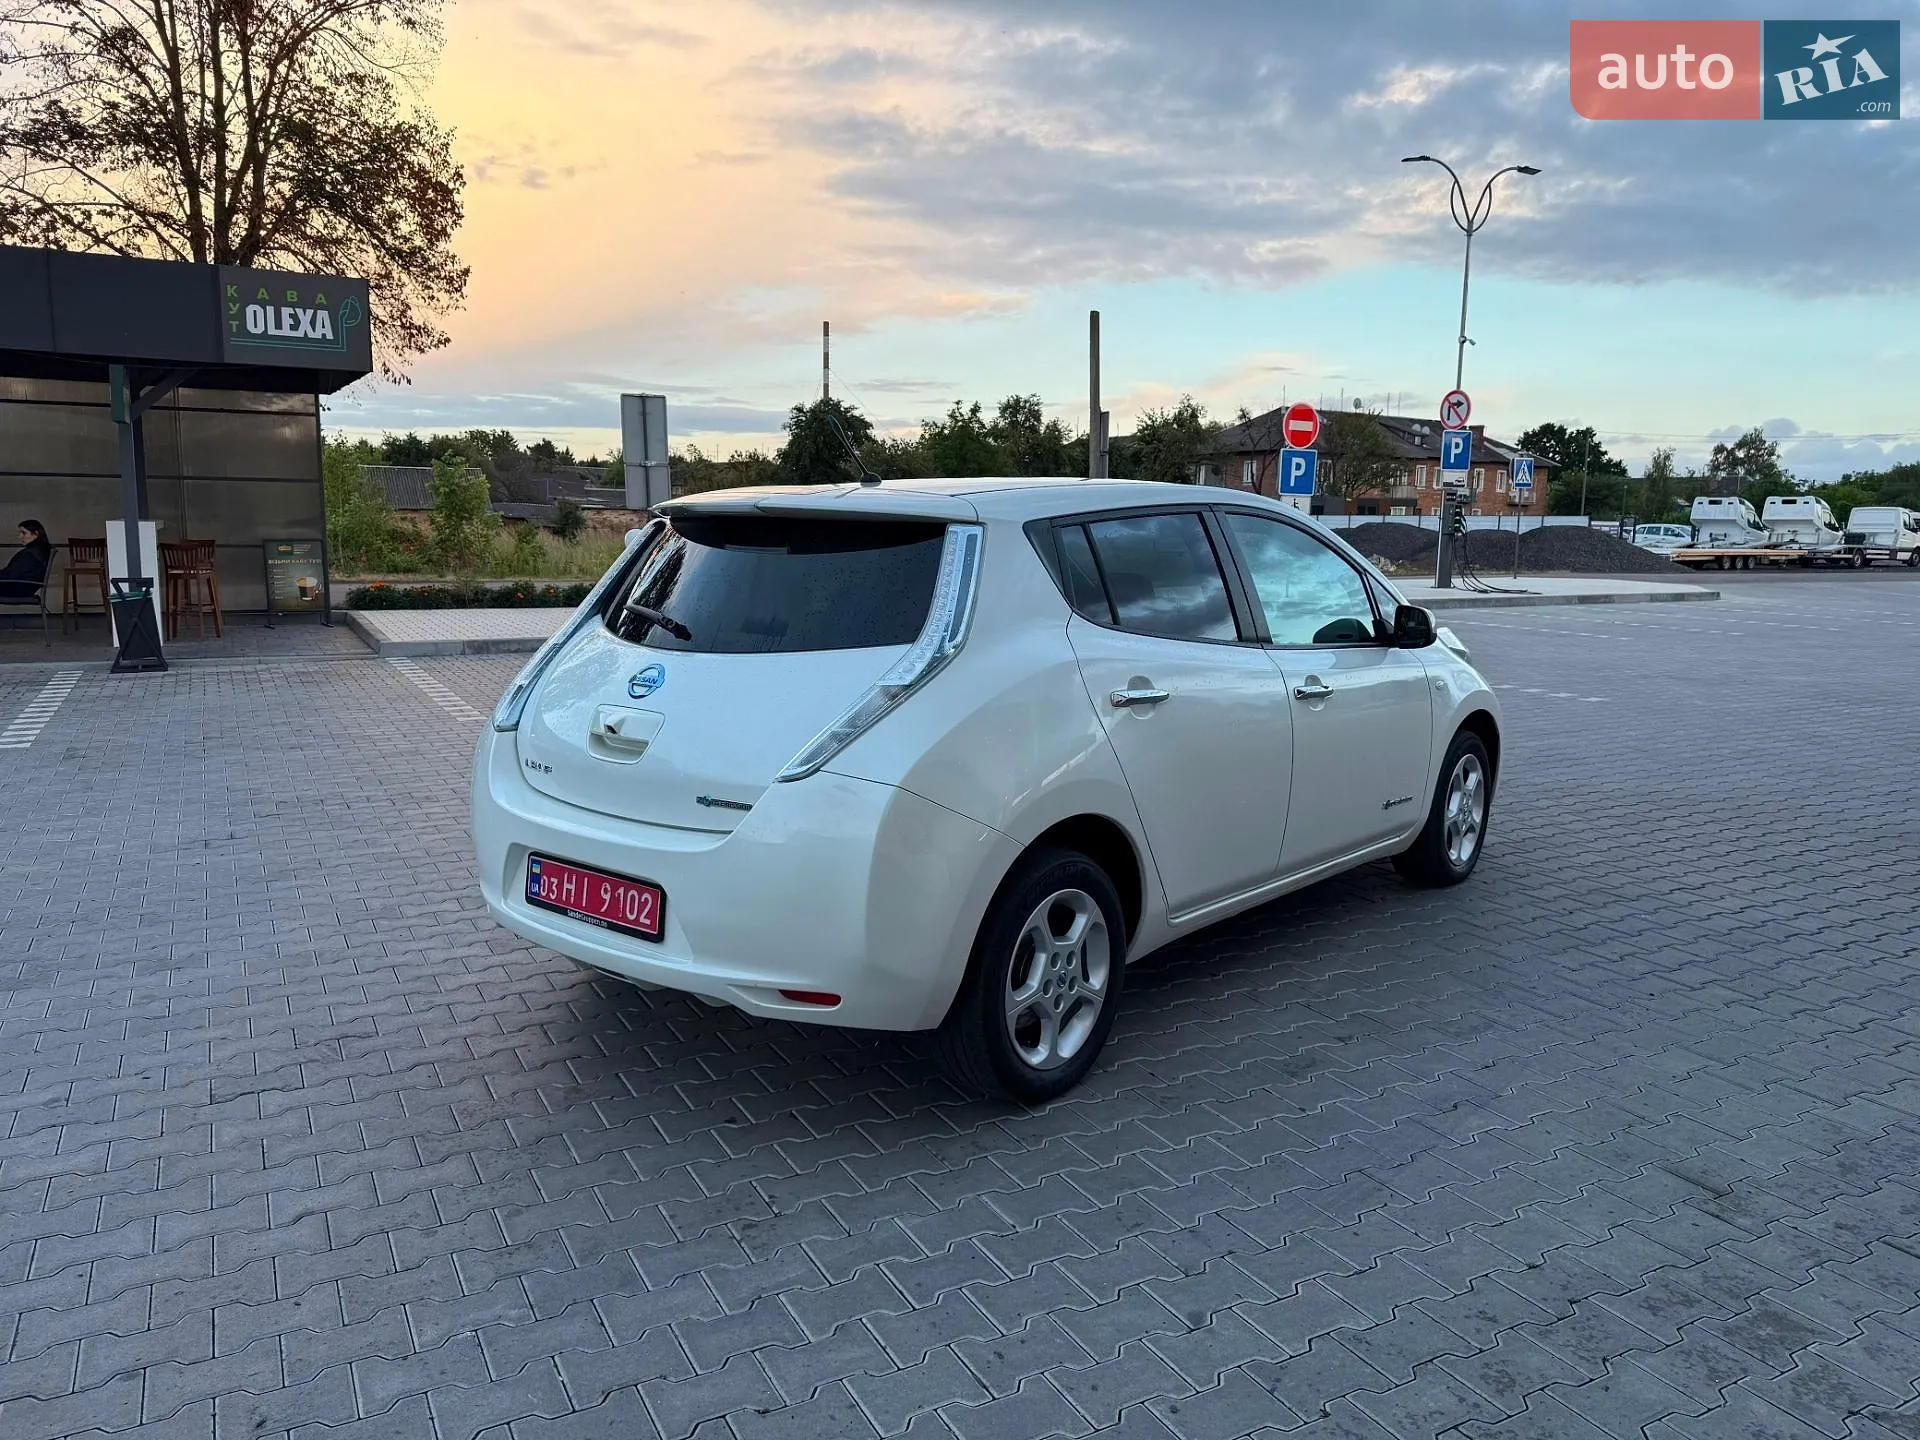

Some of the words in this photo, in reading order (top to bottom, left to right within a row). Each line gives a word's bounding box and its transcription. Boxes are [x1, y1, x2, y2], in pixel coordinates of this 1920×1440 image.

[245, 304, 334, 340] OLEXA
[1450, 437, 1464, 464] P
[1290, 457, 1306, 487] P
[531, 882, 539, 894] UA
[600, 882, 653, 926] 9102
